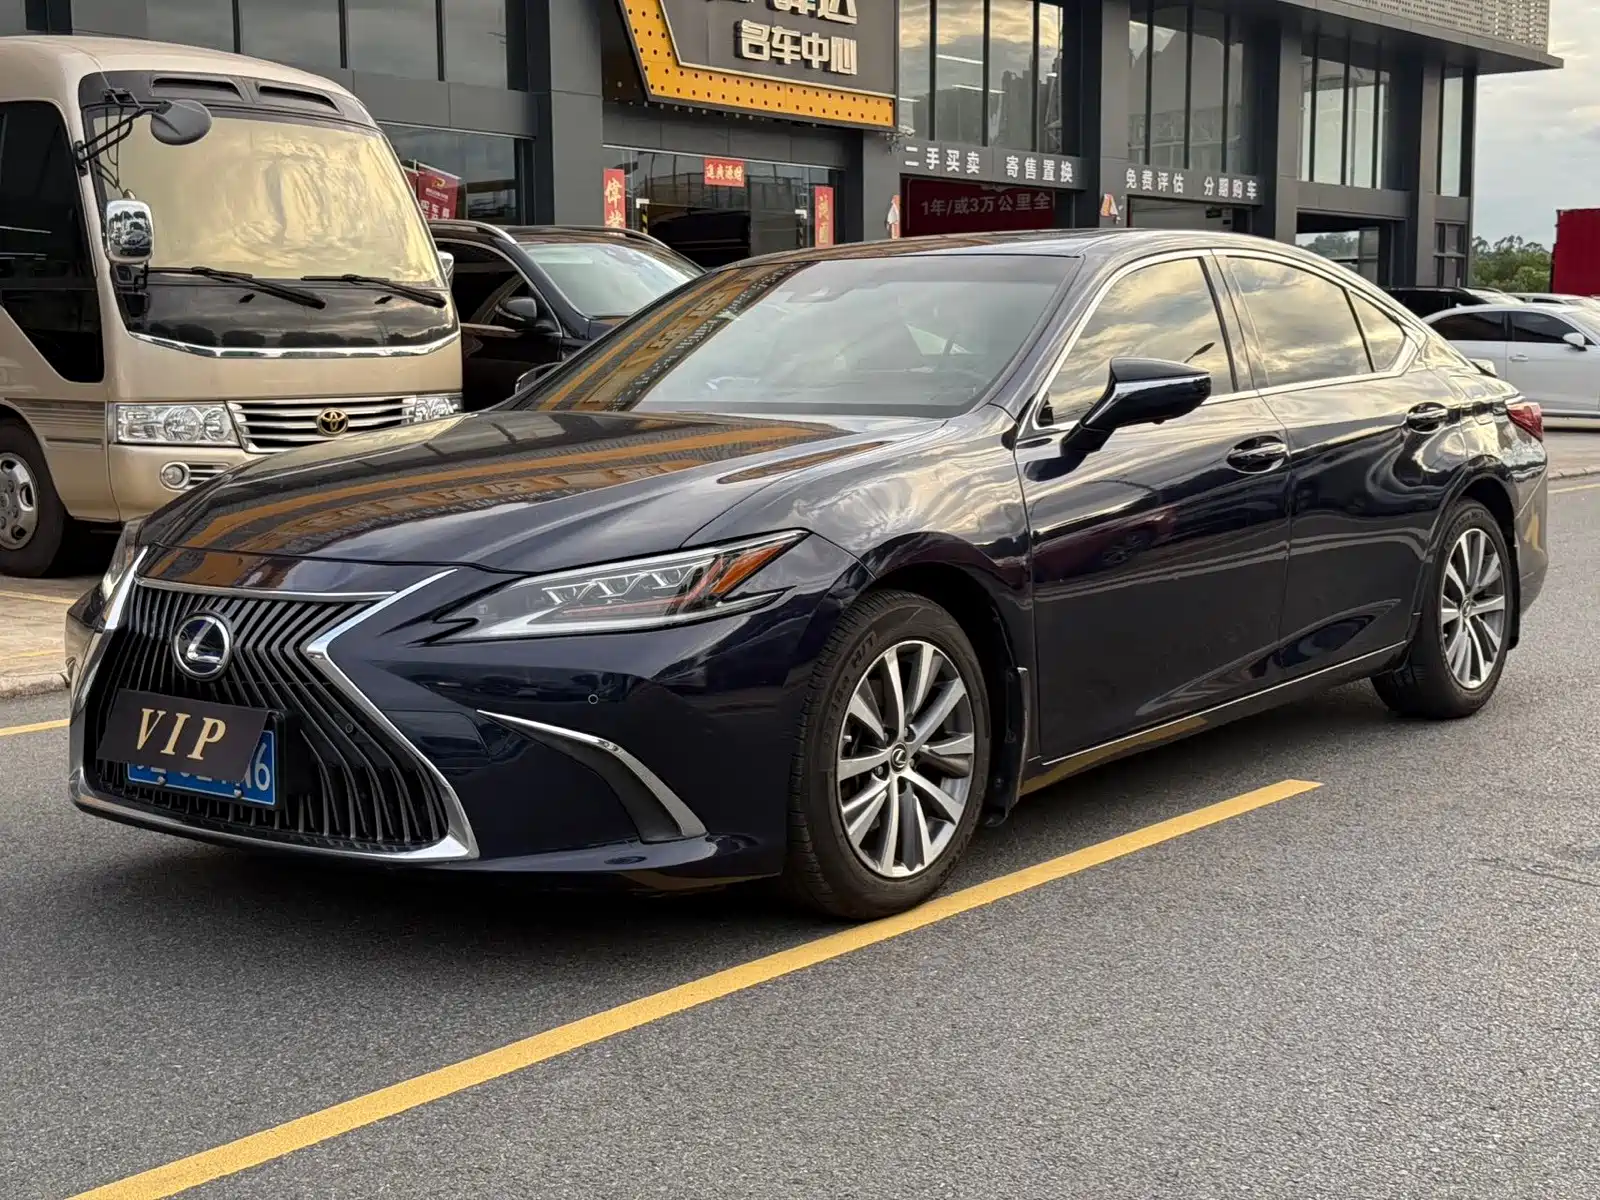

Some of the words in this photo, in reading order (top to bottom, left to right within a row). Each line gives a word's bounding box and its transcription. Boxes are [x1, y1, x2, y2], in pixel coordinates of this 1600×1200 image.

[741, 19, 857, 75] 名车中心
[904, 146, 981, 175] 二手买卖
[1006, 155, 1073, 183] 寄售置换
[1126, 168, 1184, 193] 免费评估
[1204, 176, 1257, 200] 分期购车
[136, 708, 227, 760] VIP
